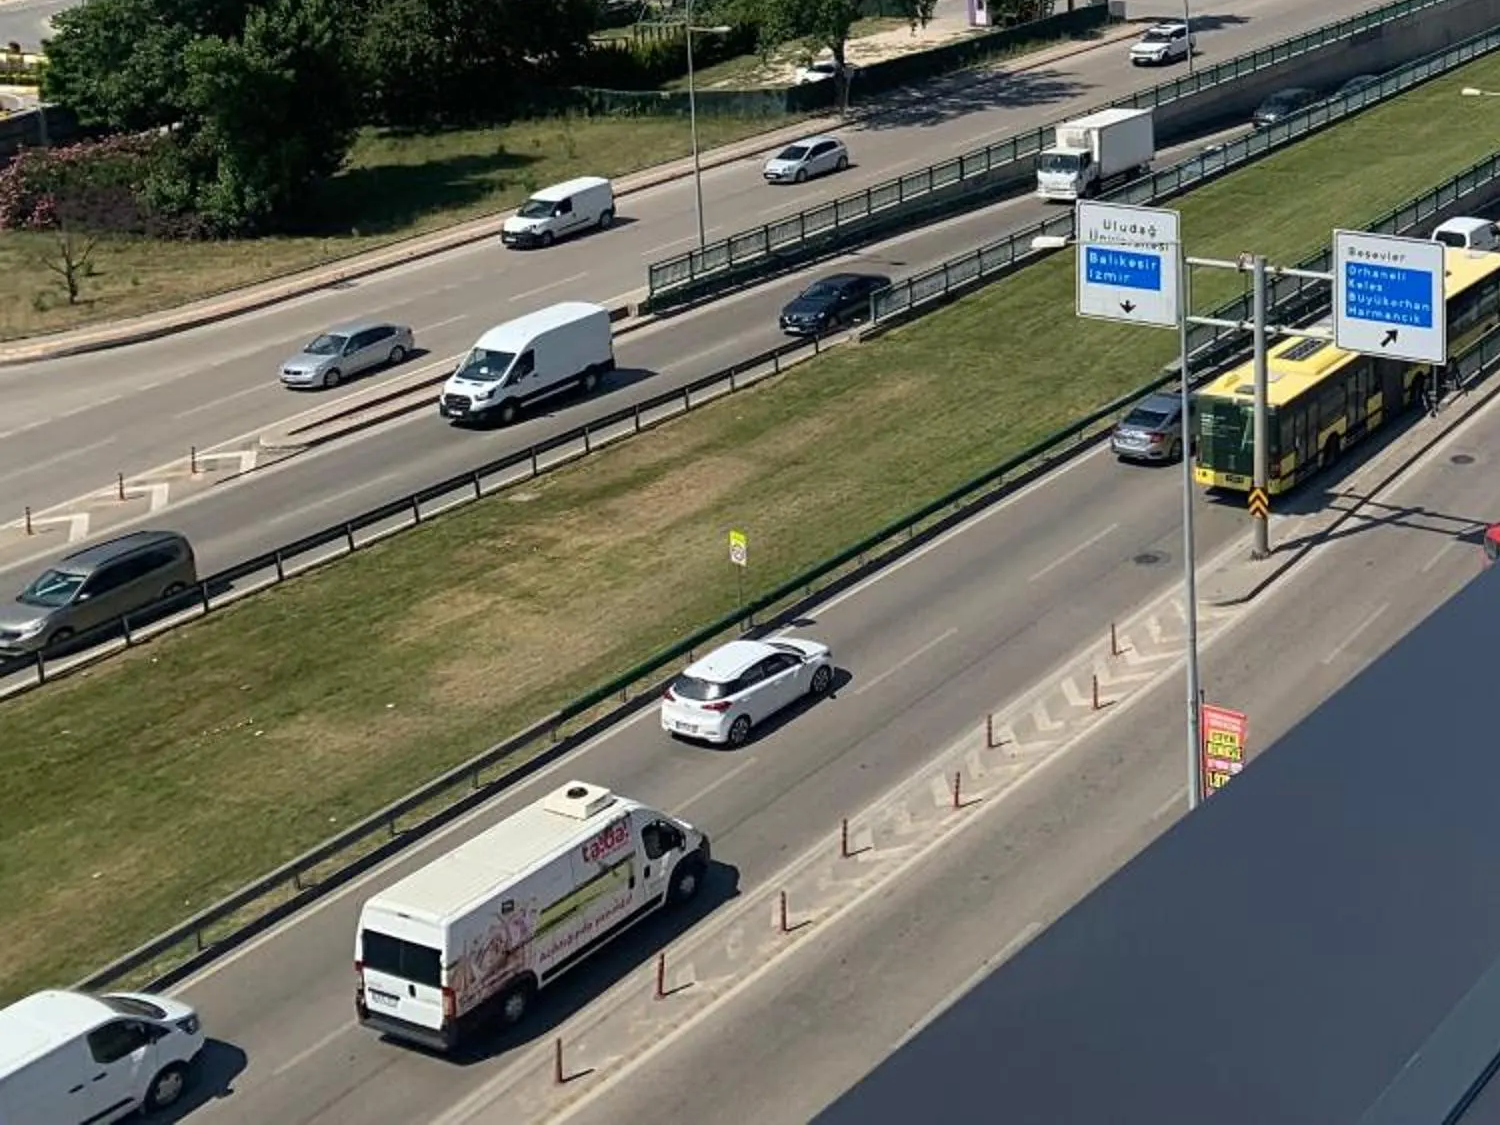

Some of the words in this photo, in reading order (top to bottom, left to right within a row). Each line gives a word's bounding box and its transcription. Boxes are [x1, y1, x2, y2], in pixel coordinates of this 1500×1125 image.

[1103, 219, 1156, 237] Uludağ
[1348, 264, 1407, 281] Orhaneli
[1348, 278, 1383, 292] Keles
